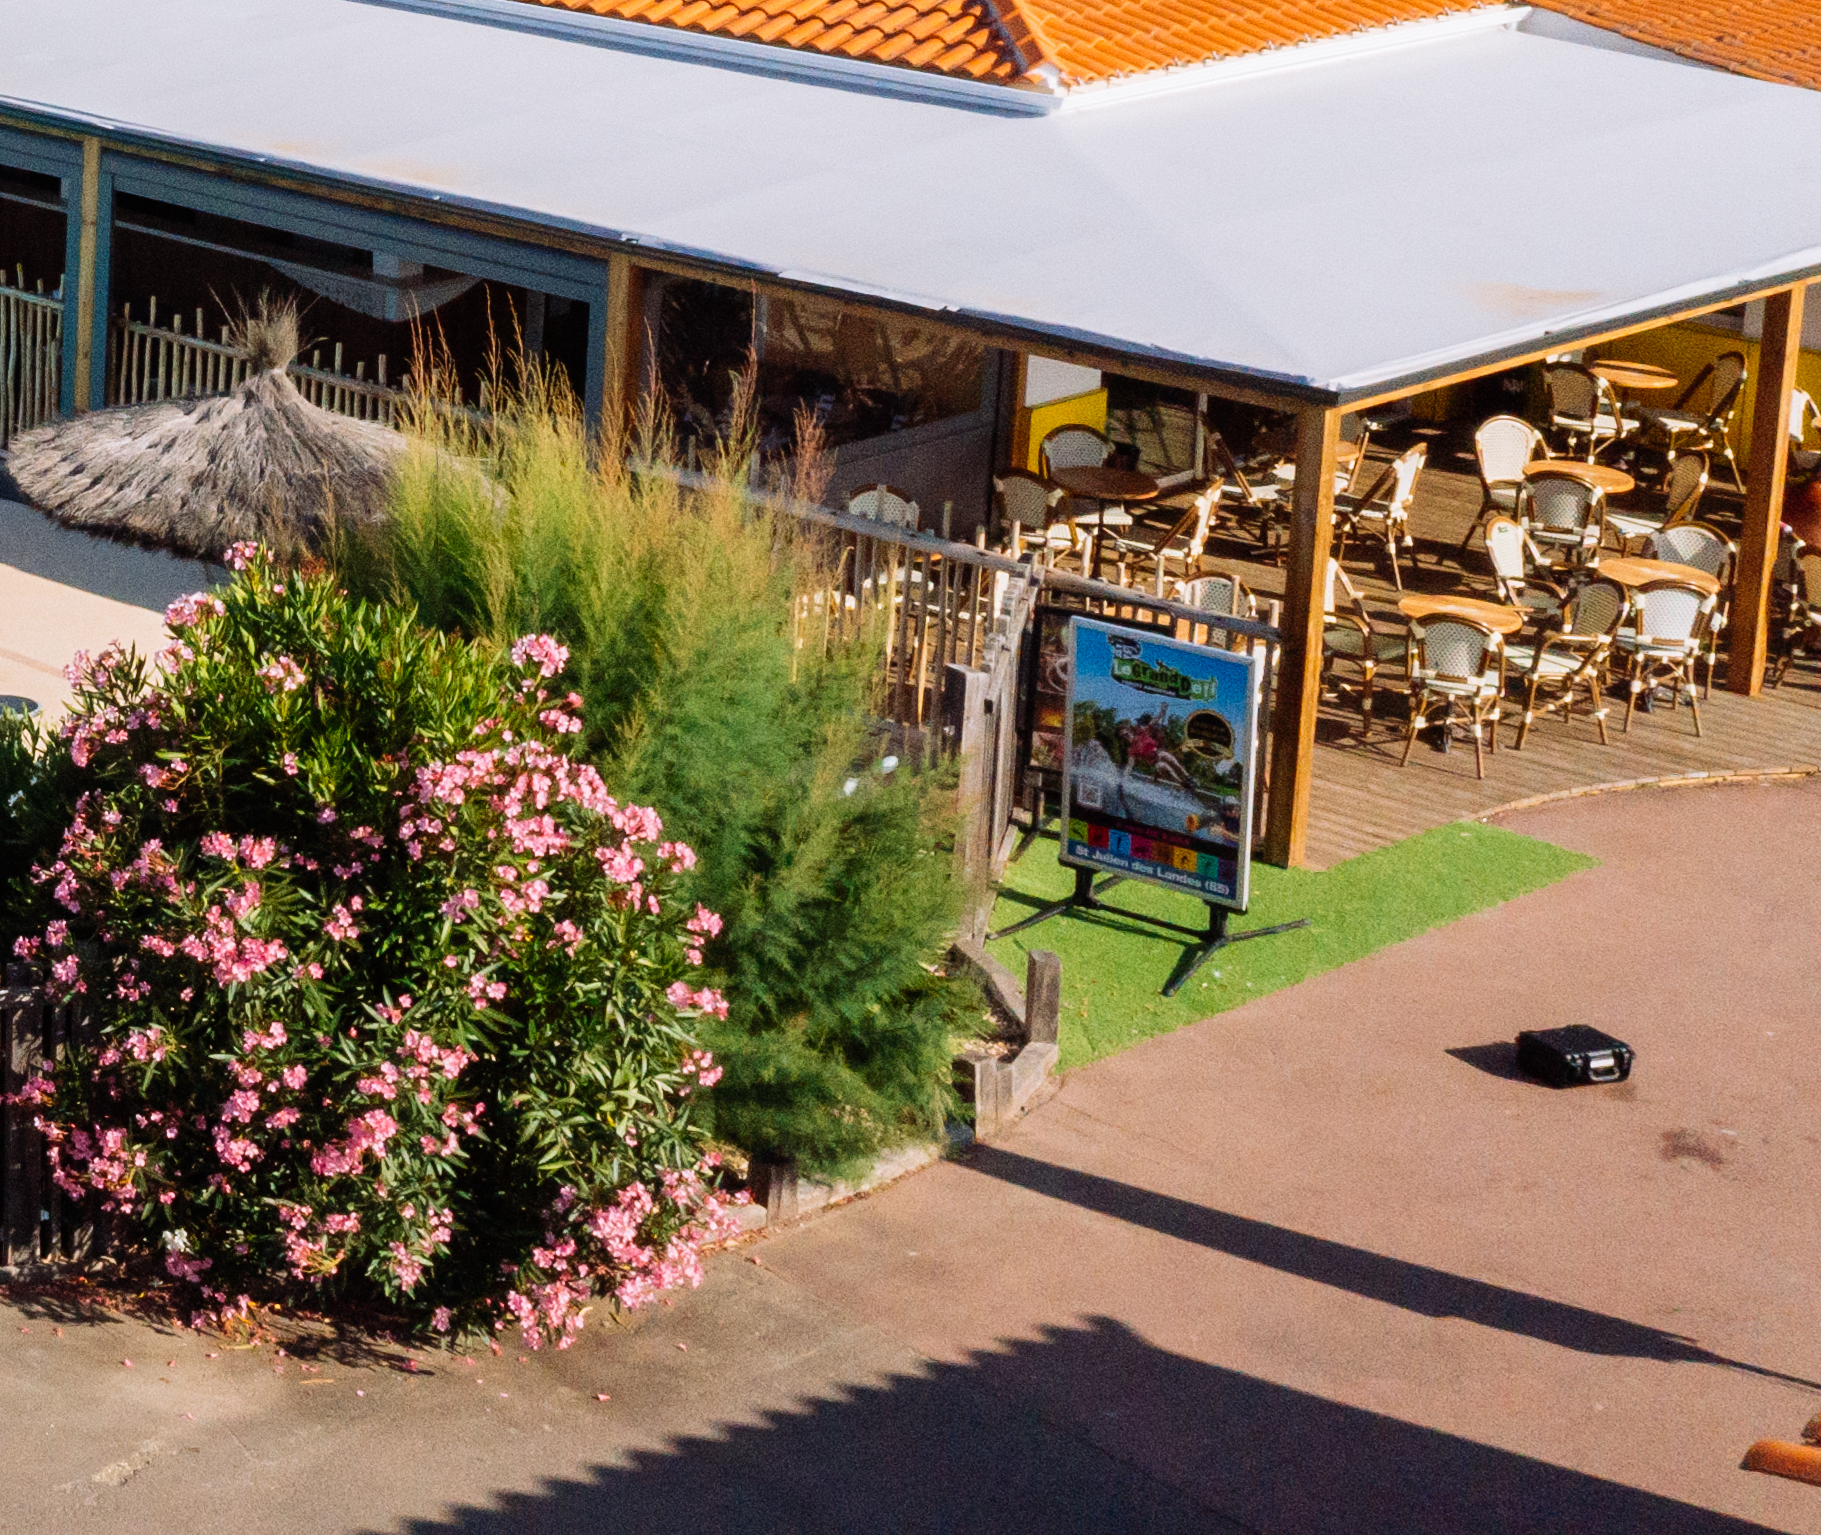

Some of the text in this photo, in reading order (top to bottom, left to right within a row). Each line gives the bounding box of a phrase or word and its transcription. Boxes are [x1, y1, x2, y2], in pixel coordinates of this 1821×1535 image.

[1114, 659, 1131, 676] Le
[1075, 845, 1089, 856] St
[1092, 851, 1129, 867] Julien
[1132, 861, 1153, 875] des
[1157, 867, 1201, 888] Landes
